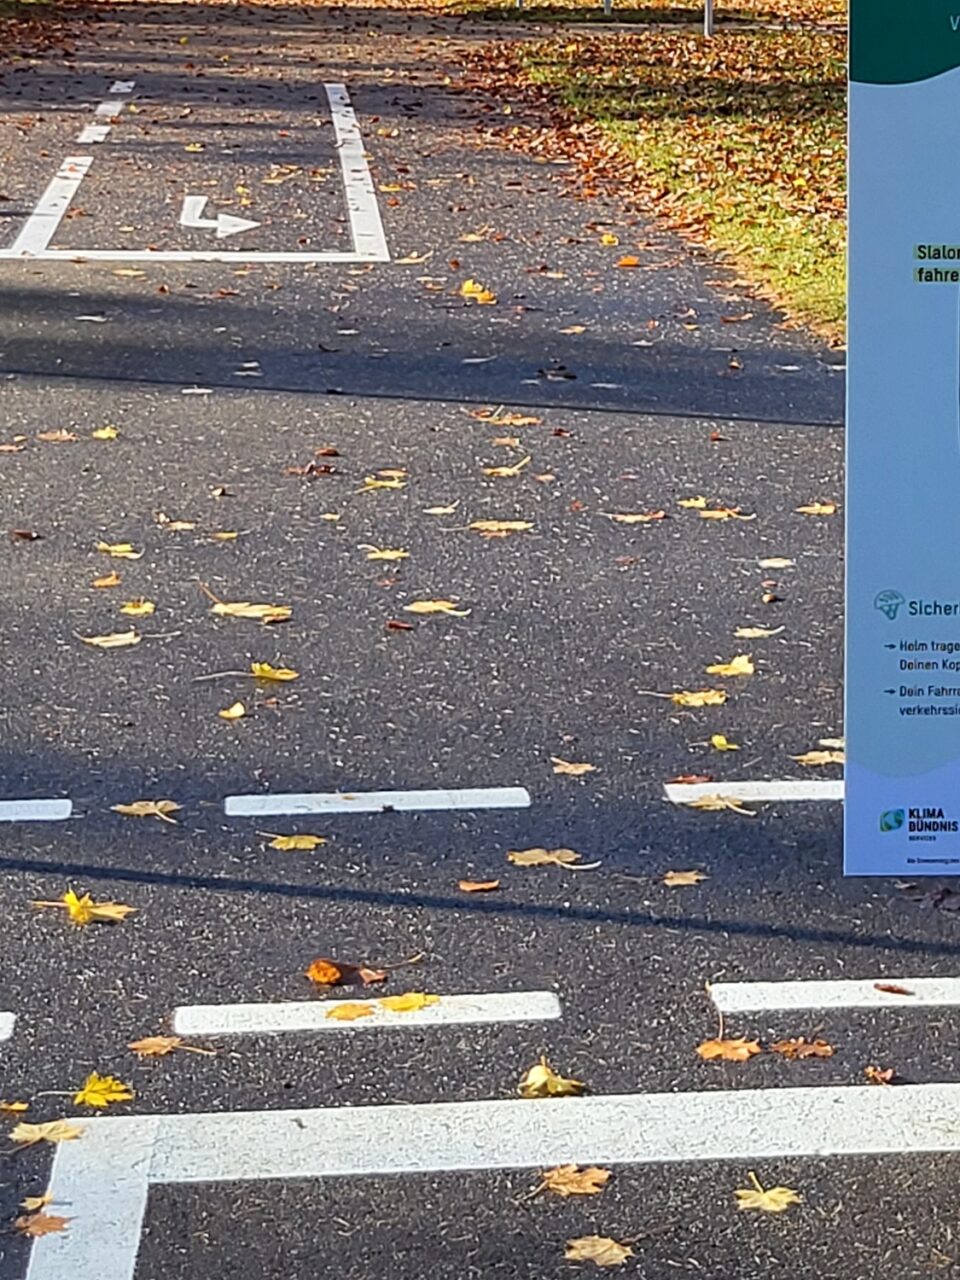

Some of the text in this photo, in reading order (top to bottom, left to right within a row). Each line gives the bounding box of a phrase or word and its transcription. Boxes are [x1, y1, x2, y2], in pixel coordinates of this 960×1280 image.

[900, 640, 927, 651] Helm
[900, 659, 938, 670] Deinen
[900, 686, 924, 697] Dein
[908, 808, 945, 819] KLIMA
[908, 821, 958, 832] BÜNDNIS
